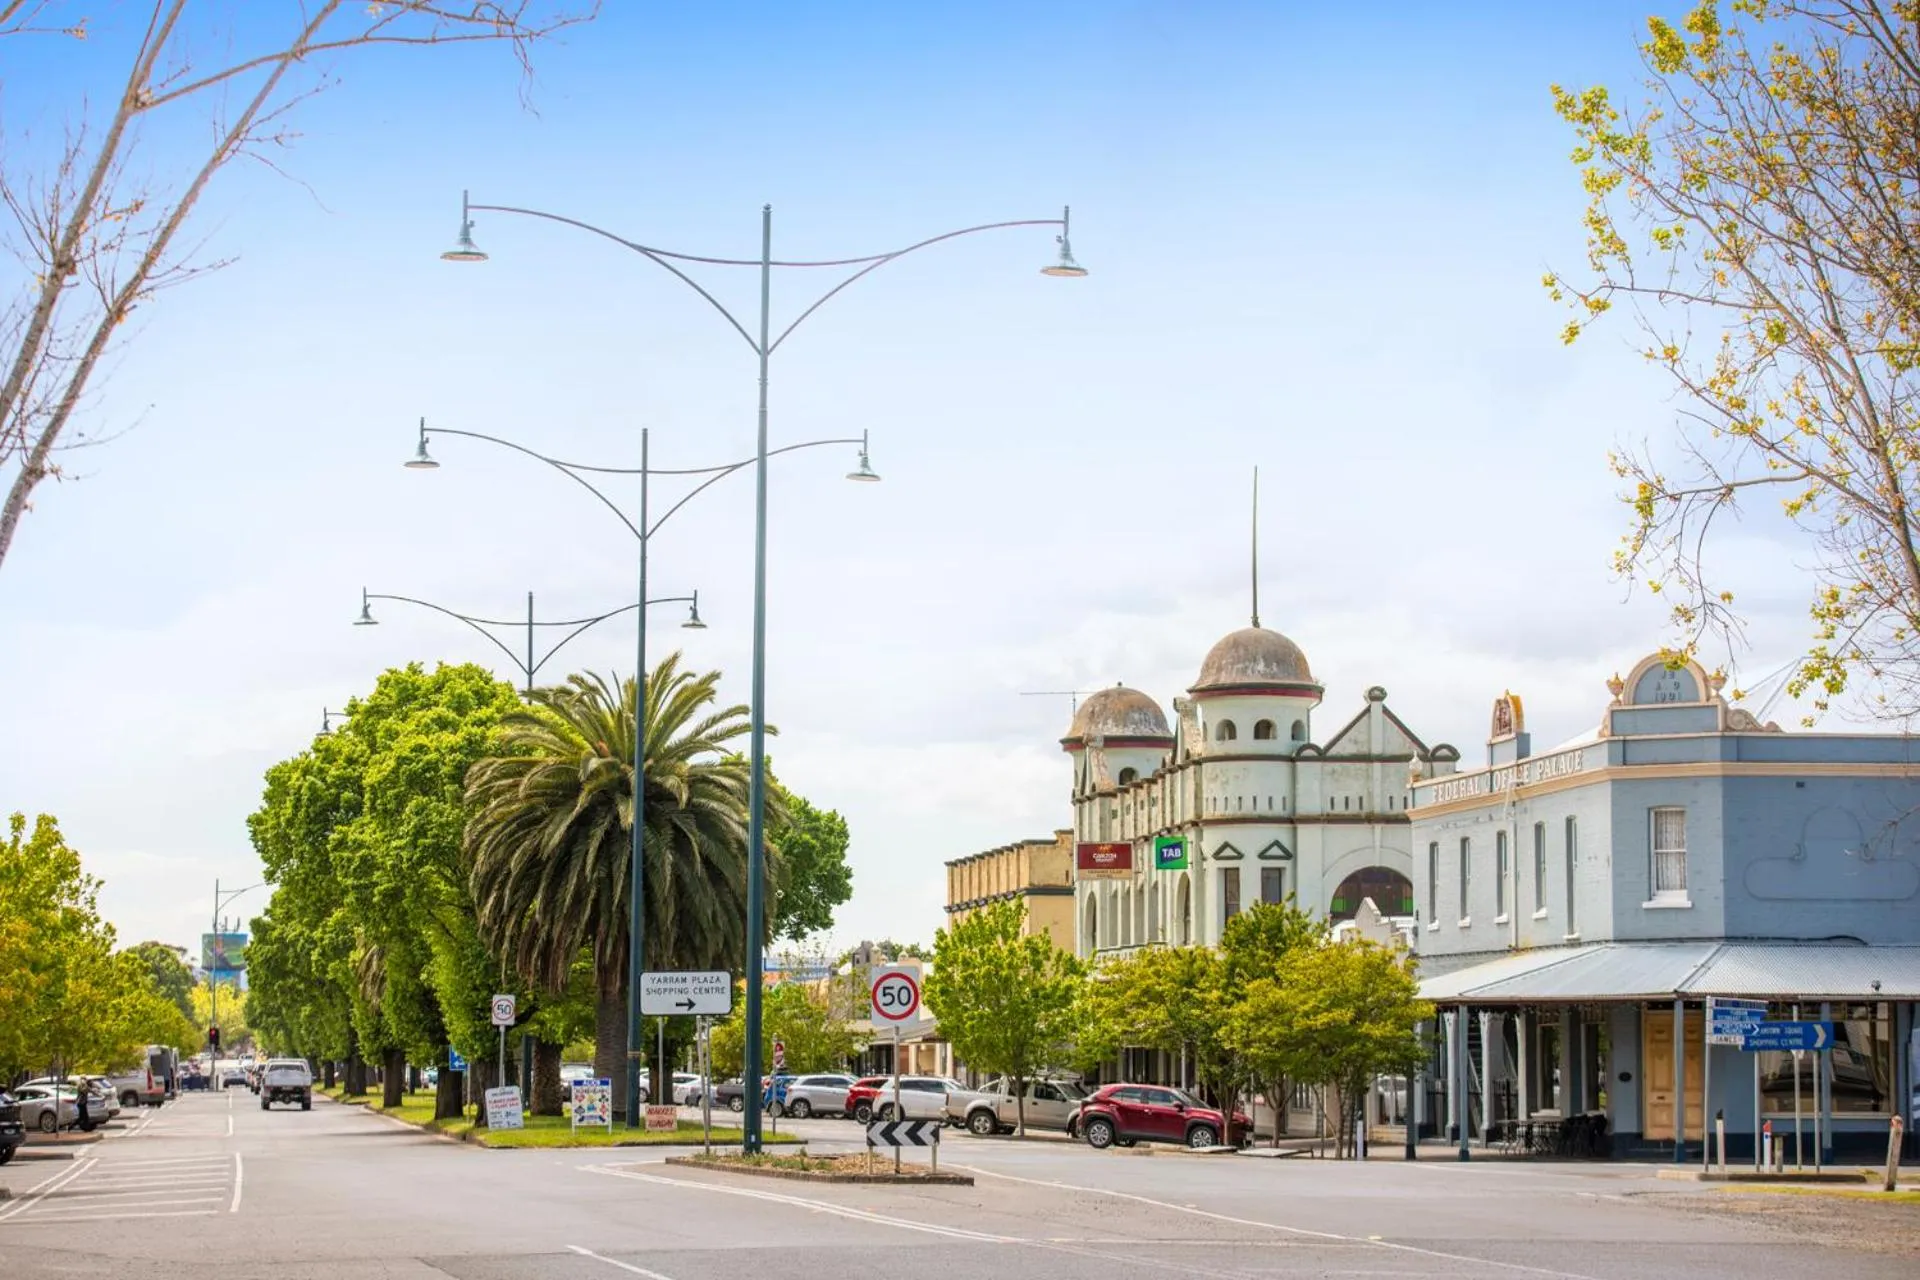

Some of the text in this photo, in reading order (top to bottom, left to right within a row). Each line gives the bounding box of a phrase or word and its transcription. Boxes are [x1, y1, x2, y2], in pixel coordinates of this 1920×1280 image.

[1432, 783, 1481, 803] FEDERAL
[1536, 749, 1583, 781] PALACE
[1162, 848, 1182, 858] TAB
[650, 975, 722, 984] YARRAM PLAZA
[645, 986, 726, 995] SHOPPING CENTRE
[882, 985, 912, 1007] 50
[497, 1003, 512, 1015] 50
